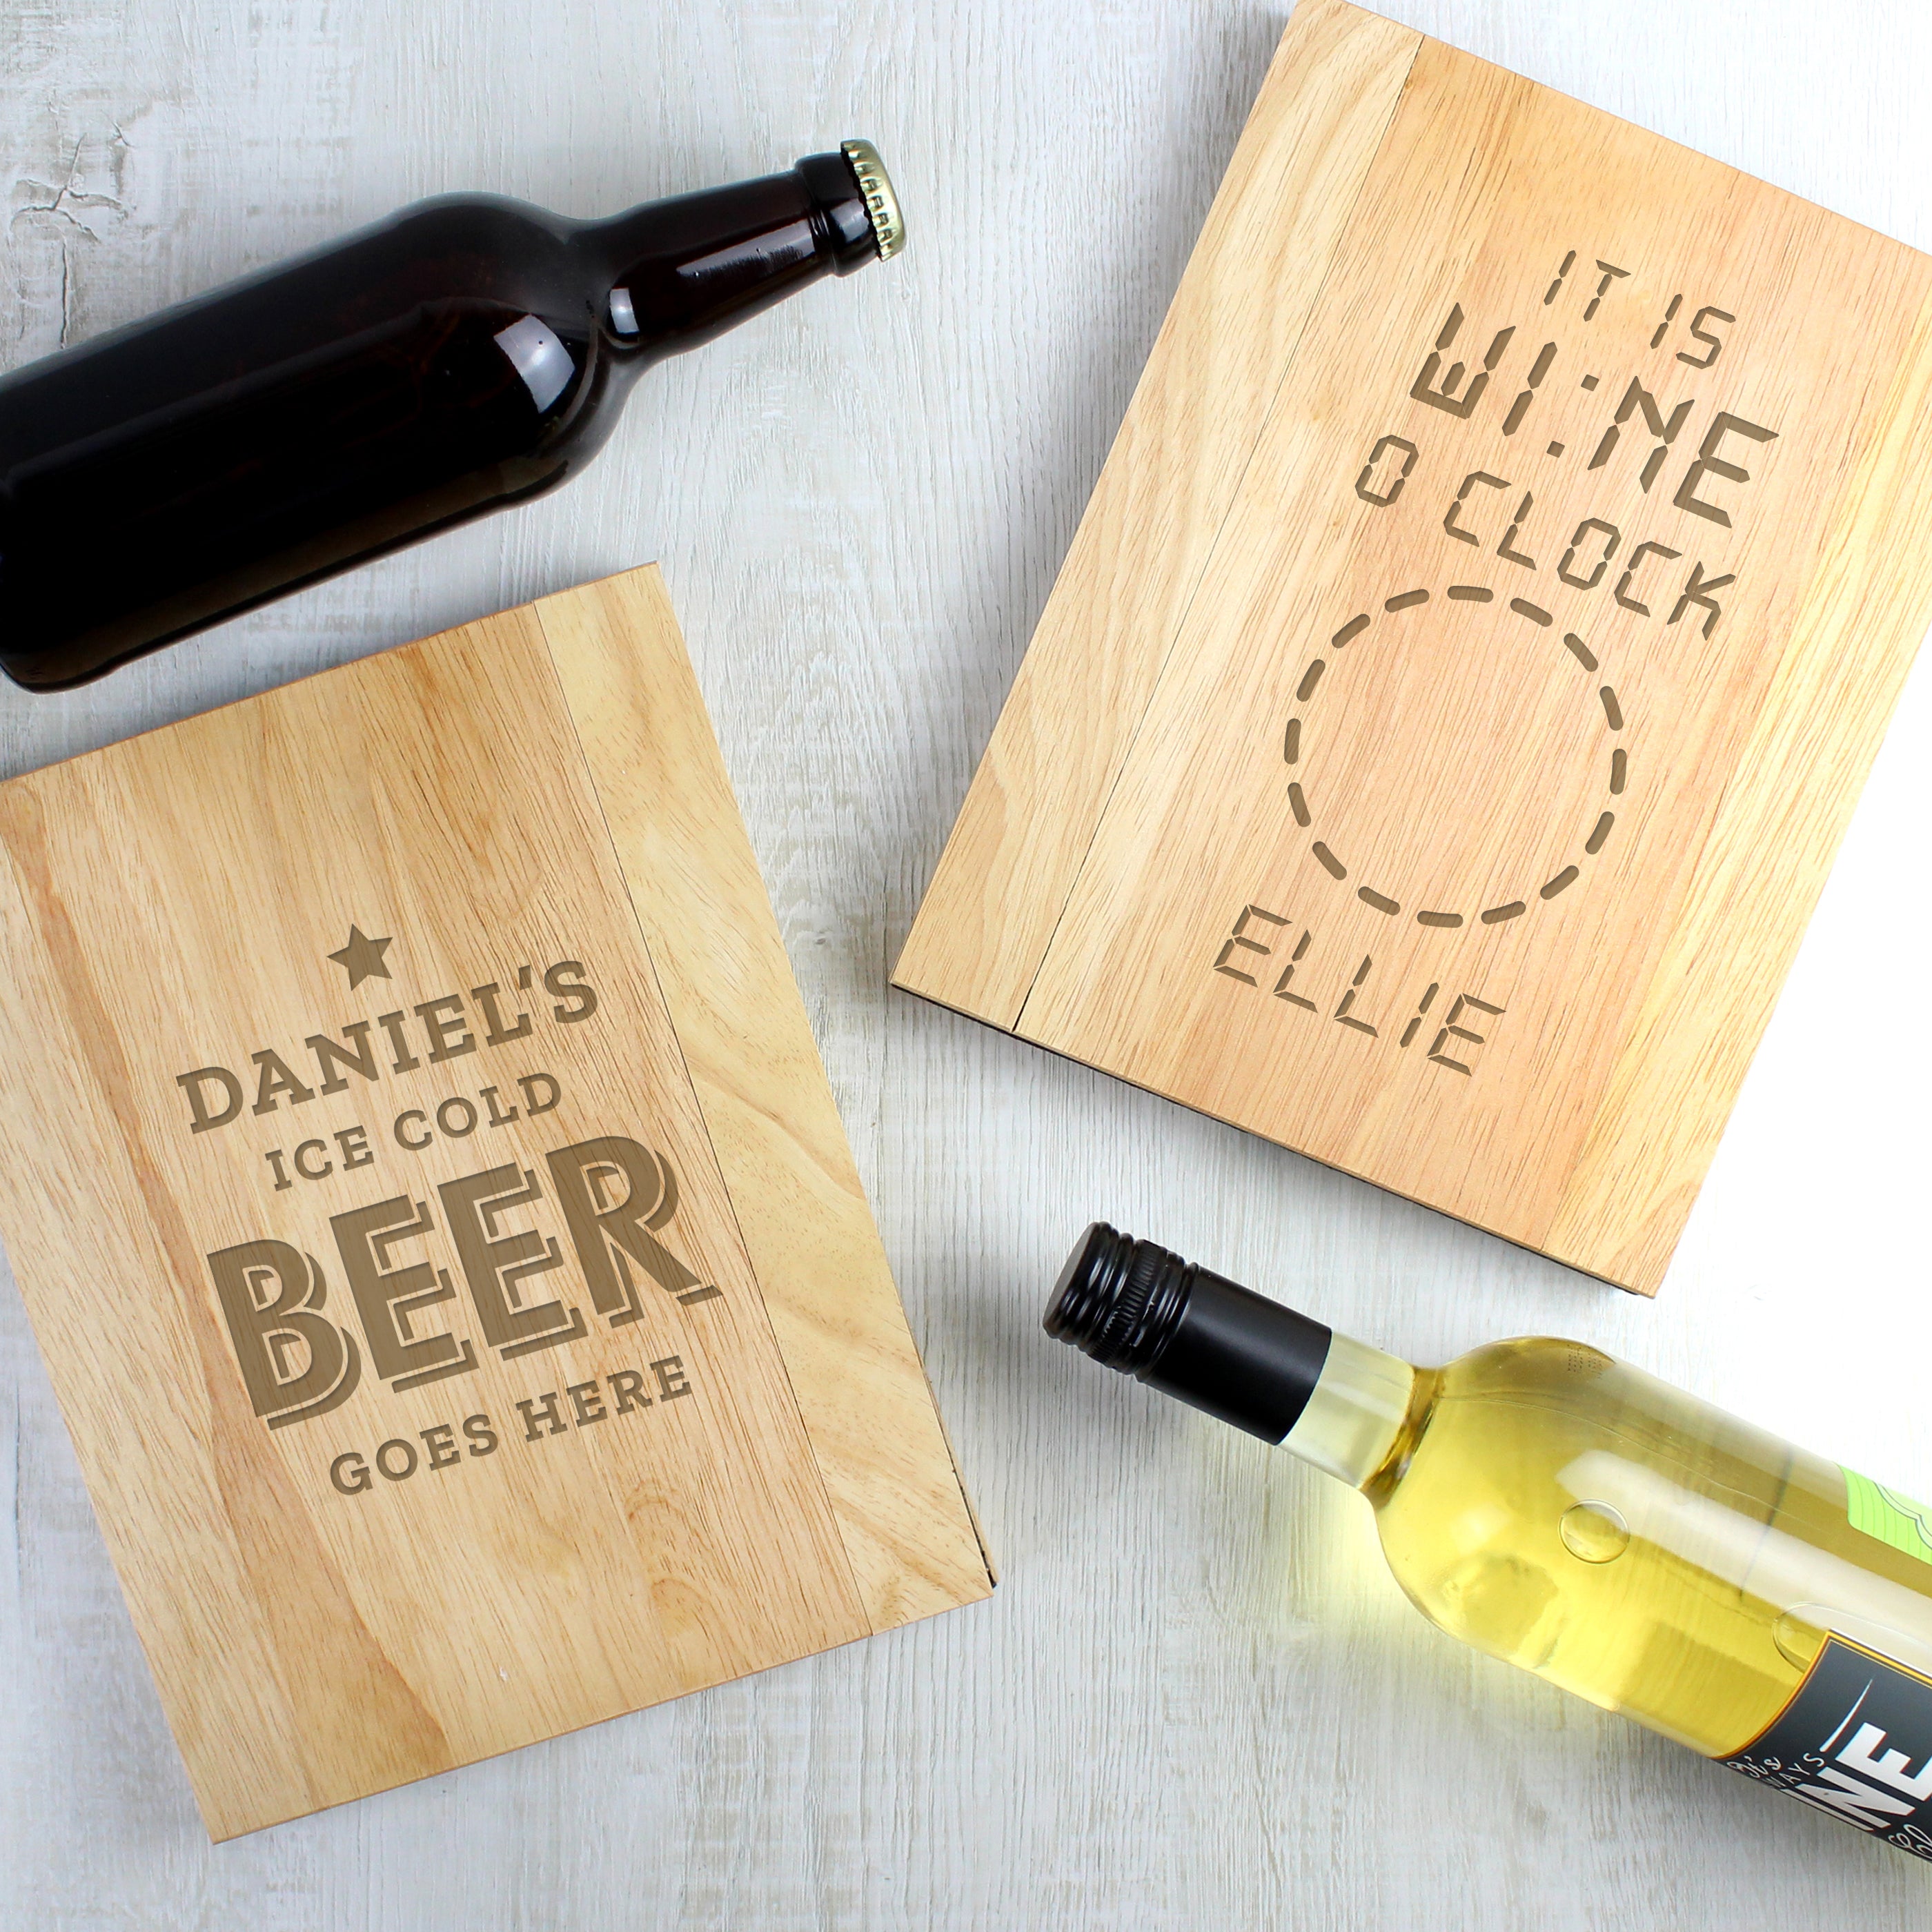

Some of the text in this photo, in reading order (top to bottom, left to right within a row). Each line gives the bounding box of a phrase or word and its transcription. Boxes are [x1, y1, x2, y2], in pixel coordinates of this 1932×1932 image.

[1544, 250, 1736, 369] IT IS
[1354, 434, 1736, 641] O CLOCK
[176, 960, 598, 1134] DANIEL'S
[1212, 904, 1507, 1077] ELLIE
[265, 1072, 562, 1191] ICE COLD
[206, 1135, 724, 1431] BEER
[329, 1355, 692, 1495] GOES HERE
